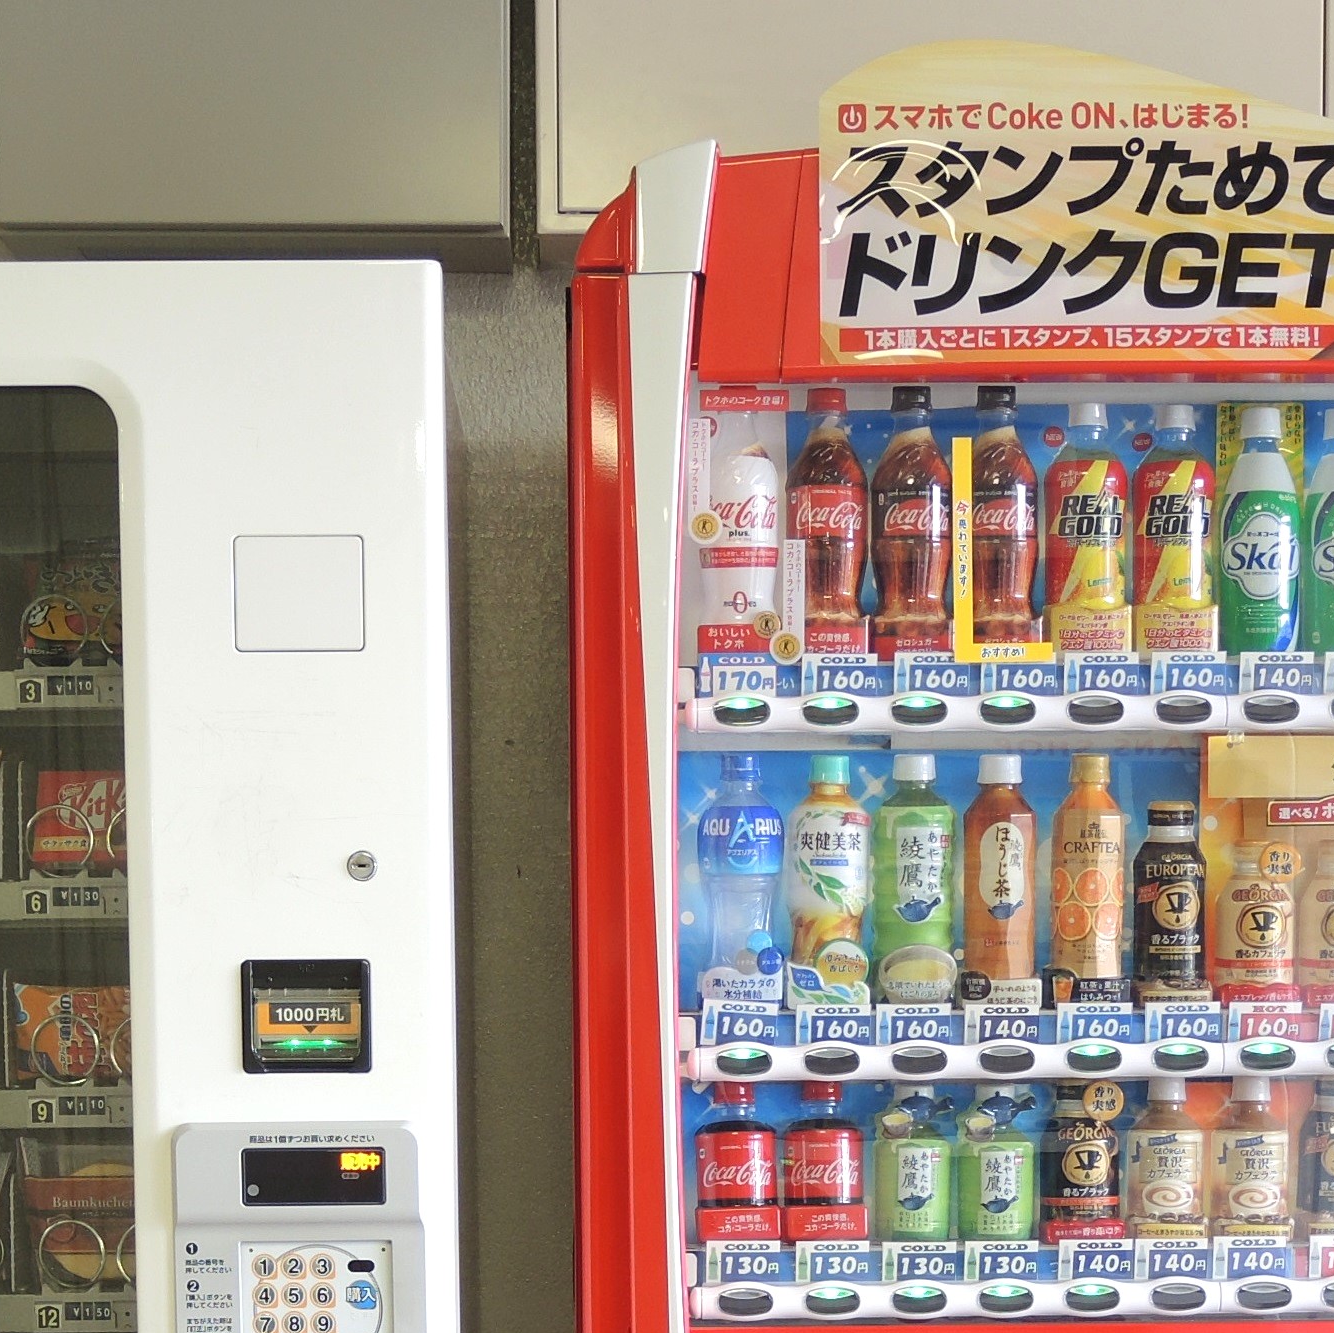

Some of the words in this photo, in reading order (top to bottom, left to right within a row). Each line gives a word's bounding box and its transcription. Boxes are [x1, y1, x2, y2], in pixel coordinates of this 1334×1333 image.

[1058, 516, 1123, 537] GOLD
[708, 627, 750, 638] おいしい
[713, 639, 743, 648] トクホ
[981, 646, 1025, 658] おすすめ!
[717, 670, 775, 688] 170円
[822, 670, 875, 688] 160円
[914, 670, 967, 687] 160円
[1001, 669, 1055, 687] 160円
[1084, 669, 1137, 687] 160円
[1171, 668, 1224, 687] 160円
[1259, 669, 1312, 686] 140円
[25, 682, 35, 702] 3
[800, 831, 862, 851] 爽健美茶
[1064, 841, 1120, 854] CRAFTEA
[901, 837, 923, 888] 綾鷹
[995, 825, 1011, 897] ほうじ茶
[1269, 851, 1292, 861] 香り
[1146, 864, 1205, 877] EUROPEAN
[31, 894, 41, 913] 6
[276, 1007, 344, 1022] 1000円札
[722, 1018, 775, 1037] 160円
[817, 1019, 870, 1037] 160円
[984, 1019, 1037, 1037] 140円
[37, 1102, 47, 1122] 9
[901, 1154, 918, 1189] 綾鷹
[985, 1156, 1002, 1193] 綾鷹
[259, 1260, 268, 1274] 1
[289, 1260, 299, 1274] 2
[317, 1260, 328, 1274] 3
[725, 1256, 778, 1274] 130円
[815, 1256, 868, 1274] 130円
[901, 1257, 954, 1274] 130円
[1078, 1252, 1130, 1272] 140円
[1154, 1252, 1206, 1271] 140円
[1231, 1251, 1284, 1270] 140円
[259, 1288, 270, 1302] 4
[289, 1288, 299, 1302] 5
[318, 1288, 328, 1302] 6
[346, 1287, 376, 1302] 購入
[39, 1308, 59, 1329] 12
[260, 1317, 270, 1332] 7
[289, 1317, 299, 1331] 8
[318, 1316, 328, 1331] 9
